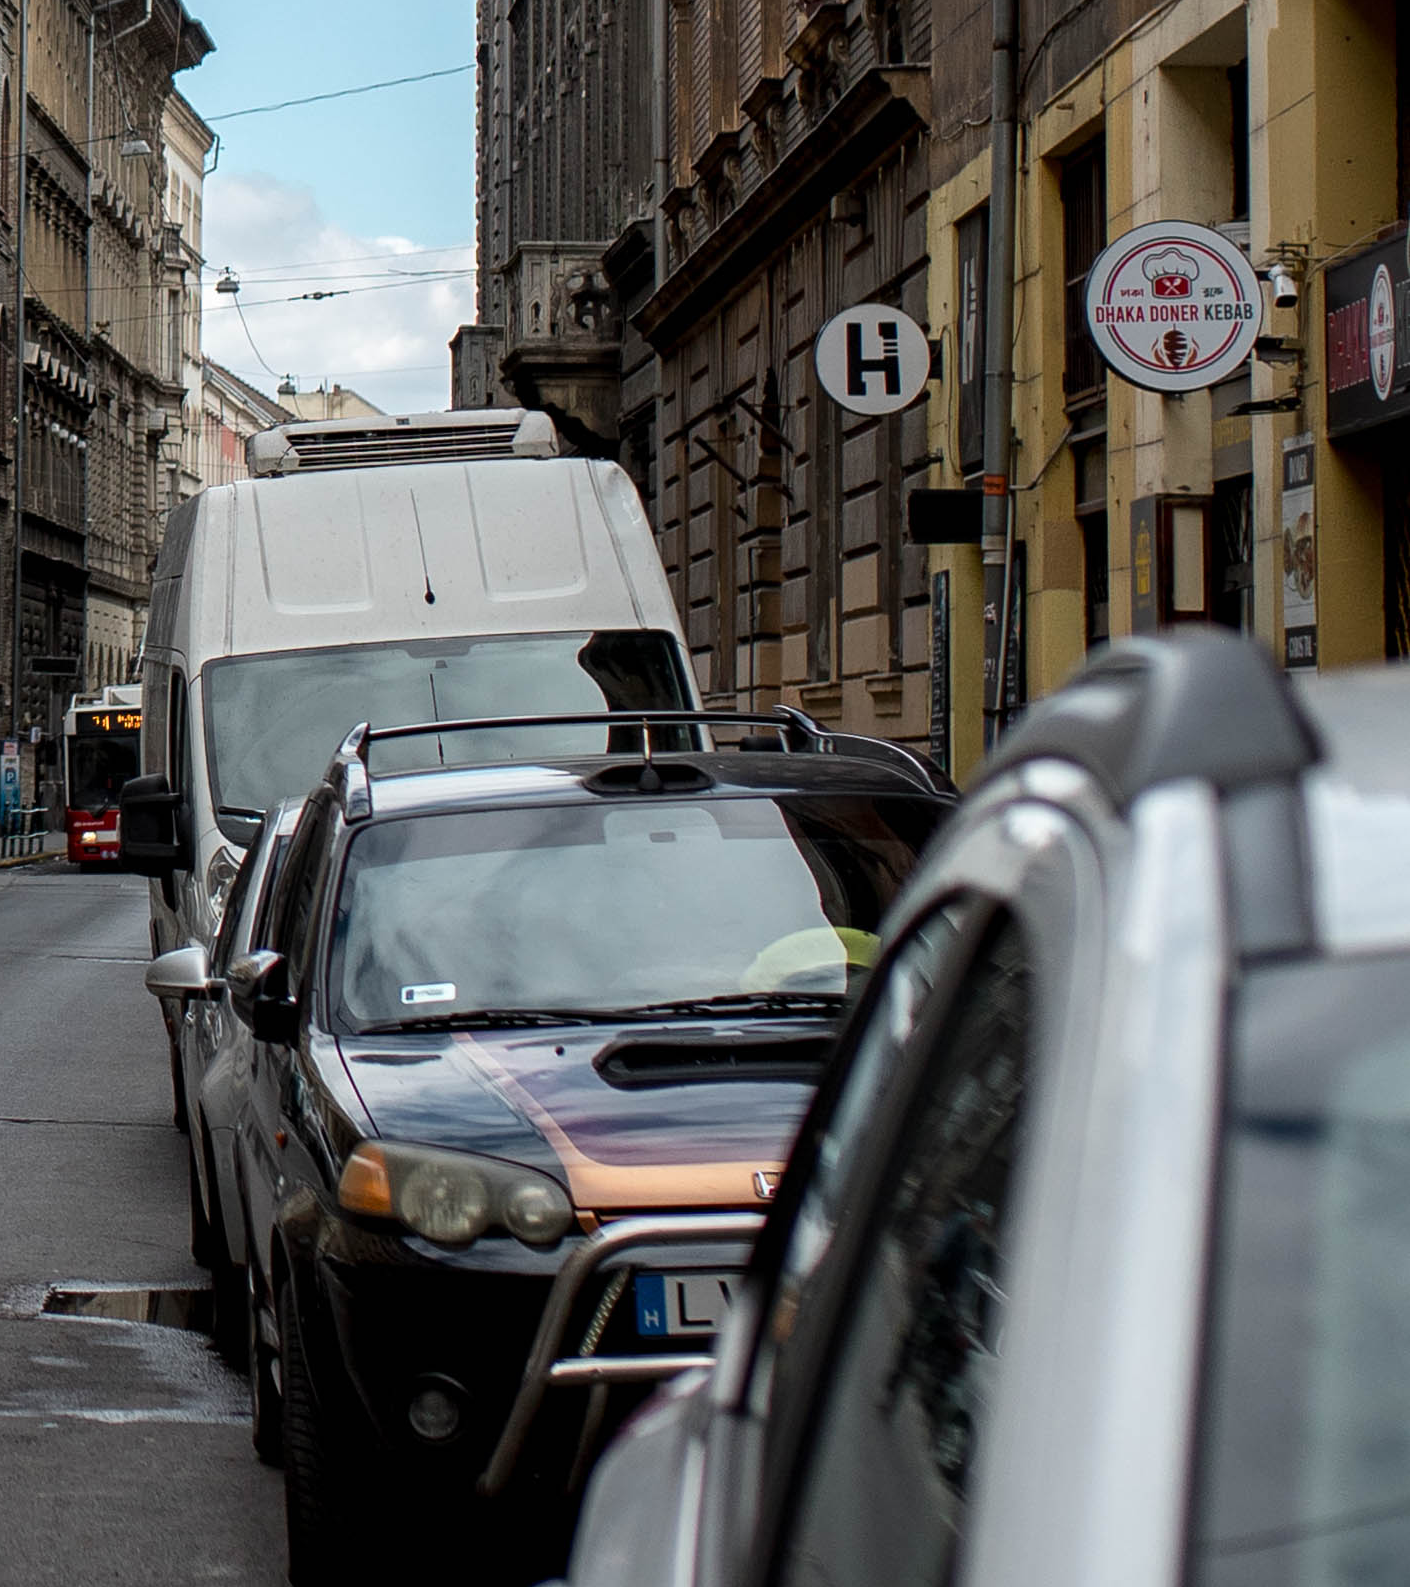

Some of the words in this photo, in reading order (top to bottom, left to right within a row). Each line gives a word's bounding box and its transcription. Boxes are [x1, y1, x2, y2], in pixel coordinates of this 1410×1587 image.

[1095, 306, 1145, 323] DHAKA
[1149, 304, 1199, 322] DONER
[1204, 302, 1253, 321] KEBAB
[643, 1309, 660, 1328] H
